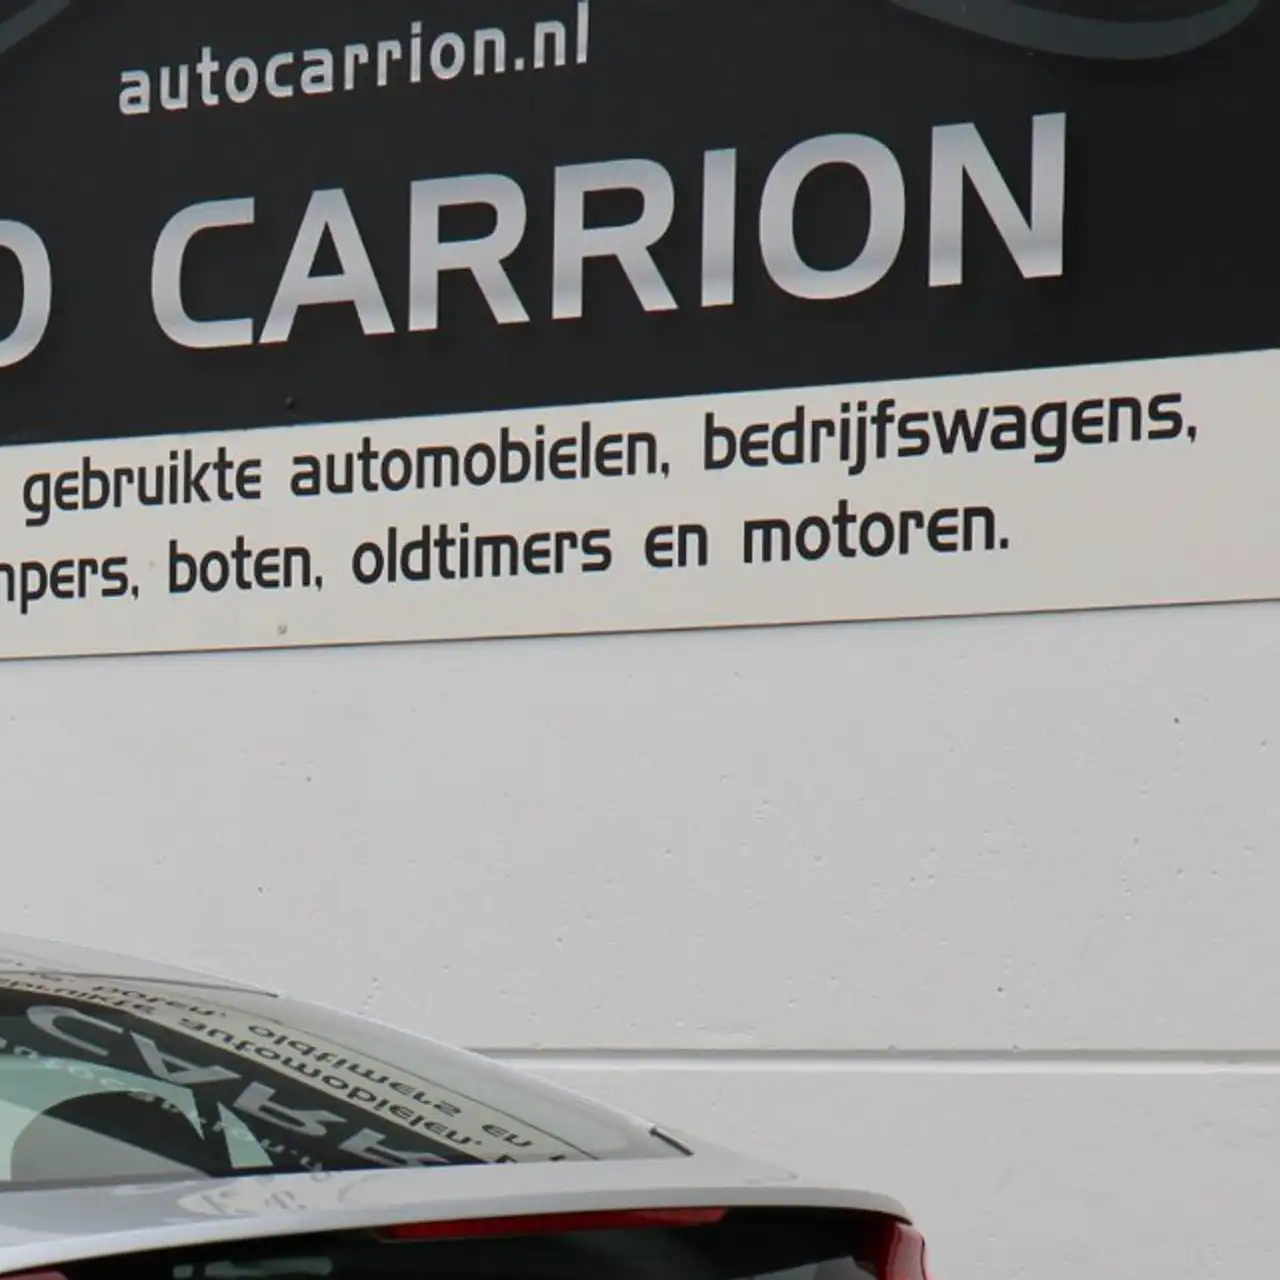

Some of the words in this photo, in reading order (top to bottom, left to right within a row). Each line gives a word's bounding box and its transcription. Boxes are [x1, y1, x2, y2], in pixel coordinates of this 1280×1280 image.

[119, 0, 589, 115] autocarrion.nl
[149, 111, 1067, 349] CARRION
[23, 447, 262, 527] gebruikte
[290, 421, 670, 497] automobielen,
[703, 393, 1198, 476] bedrijfswagens,
[168, 535, 323, 594] boten,
[352, 522, 612, 585] oldtimers
[644, 524, 708, 568] en
[743, 498, 1010, 564] motoren.
